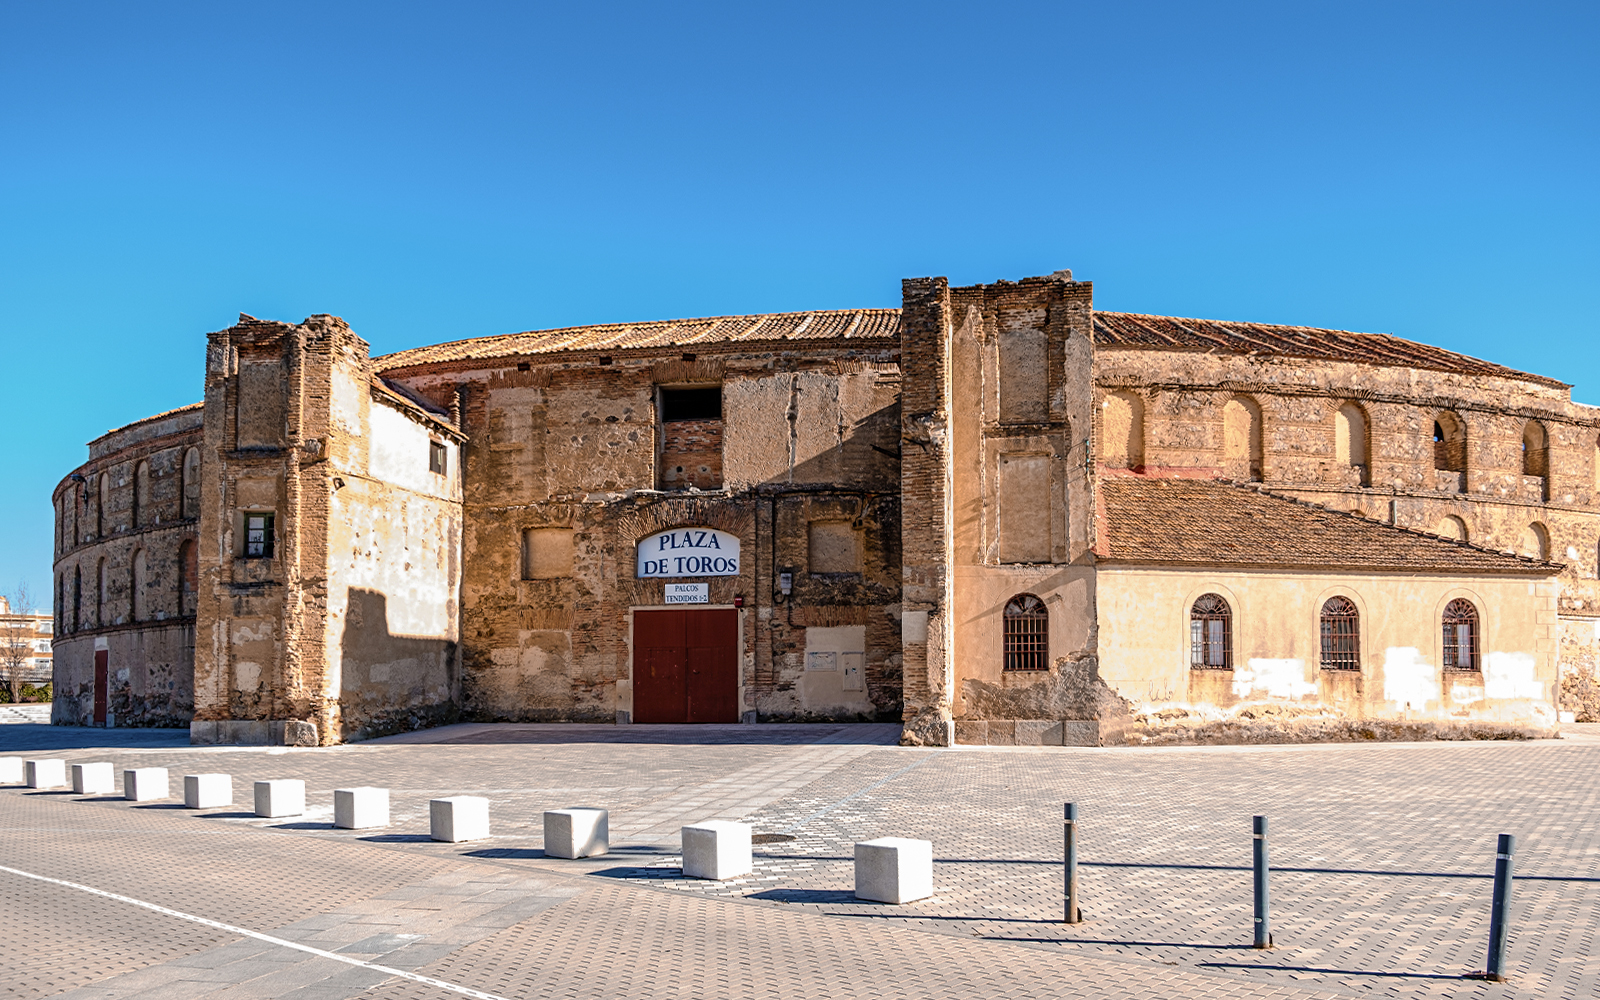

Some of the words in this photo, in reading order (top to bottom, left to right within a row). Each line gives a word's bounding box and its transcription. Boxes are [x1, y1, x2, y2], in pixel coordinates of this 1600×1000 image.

[659, 531, 721, 552] PLAZA
[643, 558, 669, 575] DE
[674, 556, 737, 573] TOROS
[674, 584, 699, 592] PALCOS
